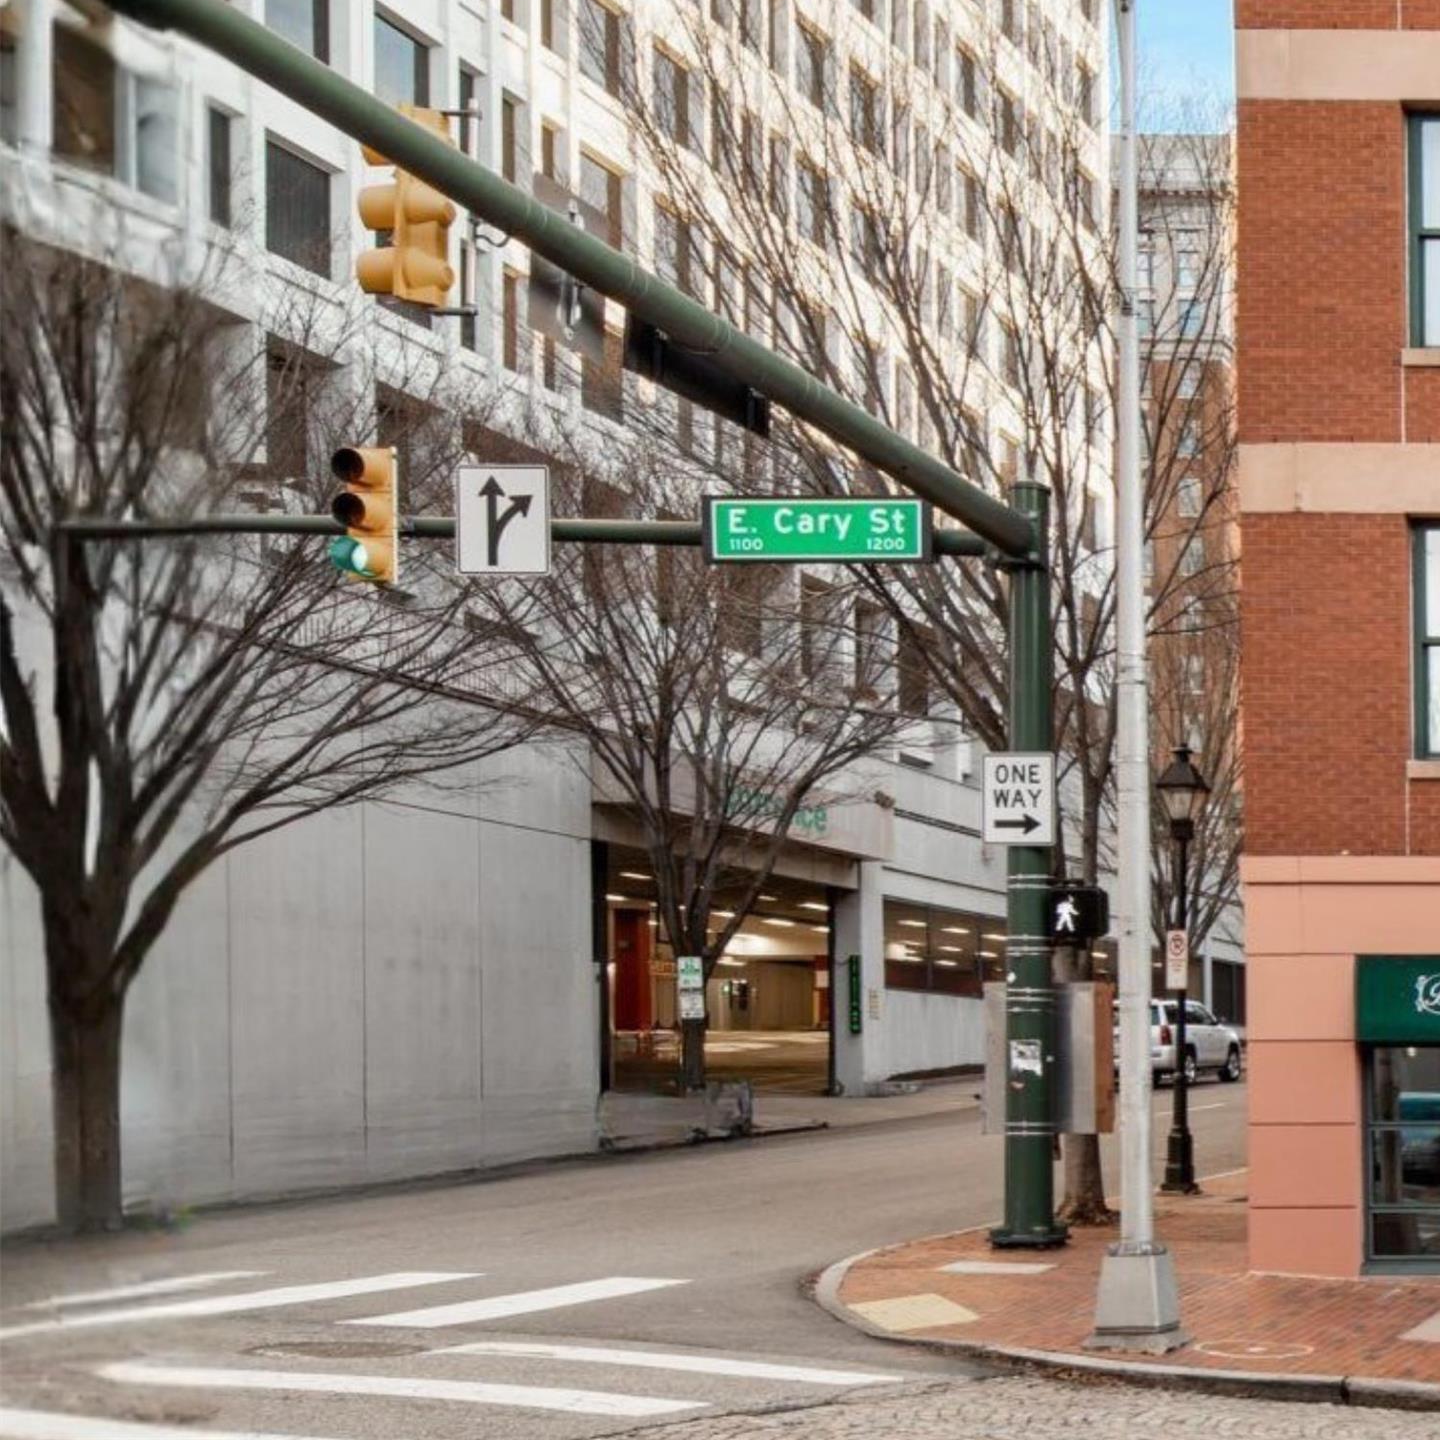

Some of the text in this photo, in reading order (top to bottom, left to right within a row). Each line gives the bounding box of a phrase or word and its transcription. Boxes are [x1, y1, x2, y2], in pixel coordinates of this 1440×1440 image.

[728, 507, 905, 541] E. Cary St
[729, 538, 764, 551] 1100
[866, 538, 905, 551] 1200
[995, 764, 1041, 784] ONE
[993, 789, 1042, 808] WAY
